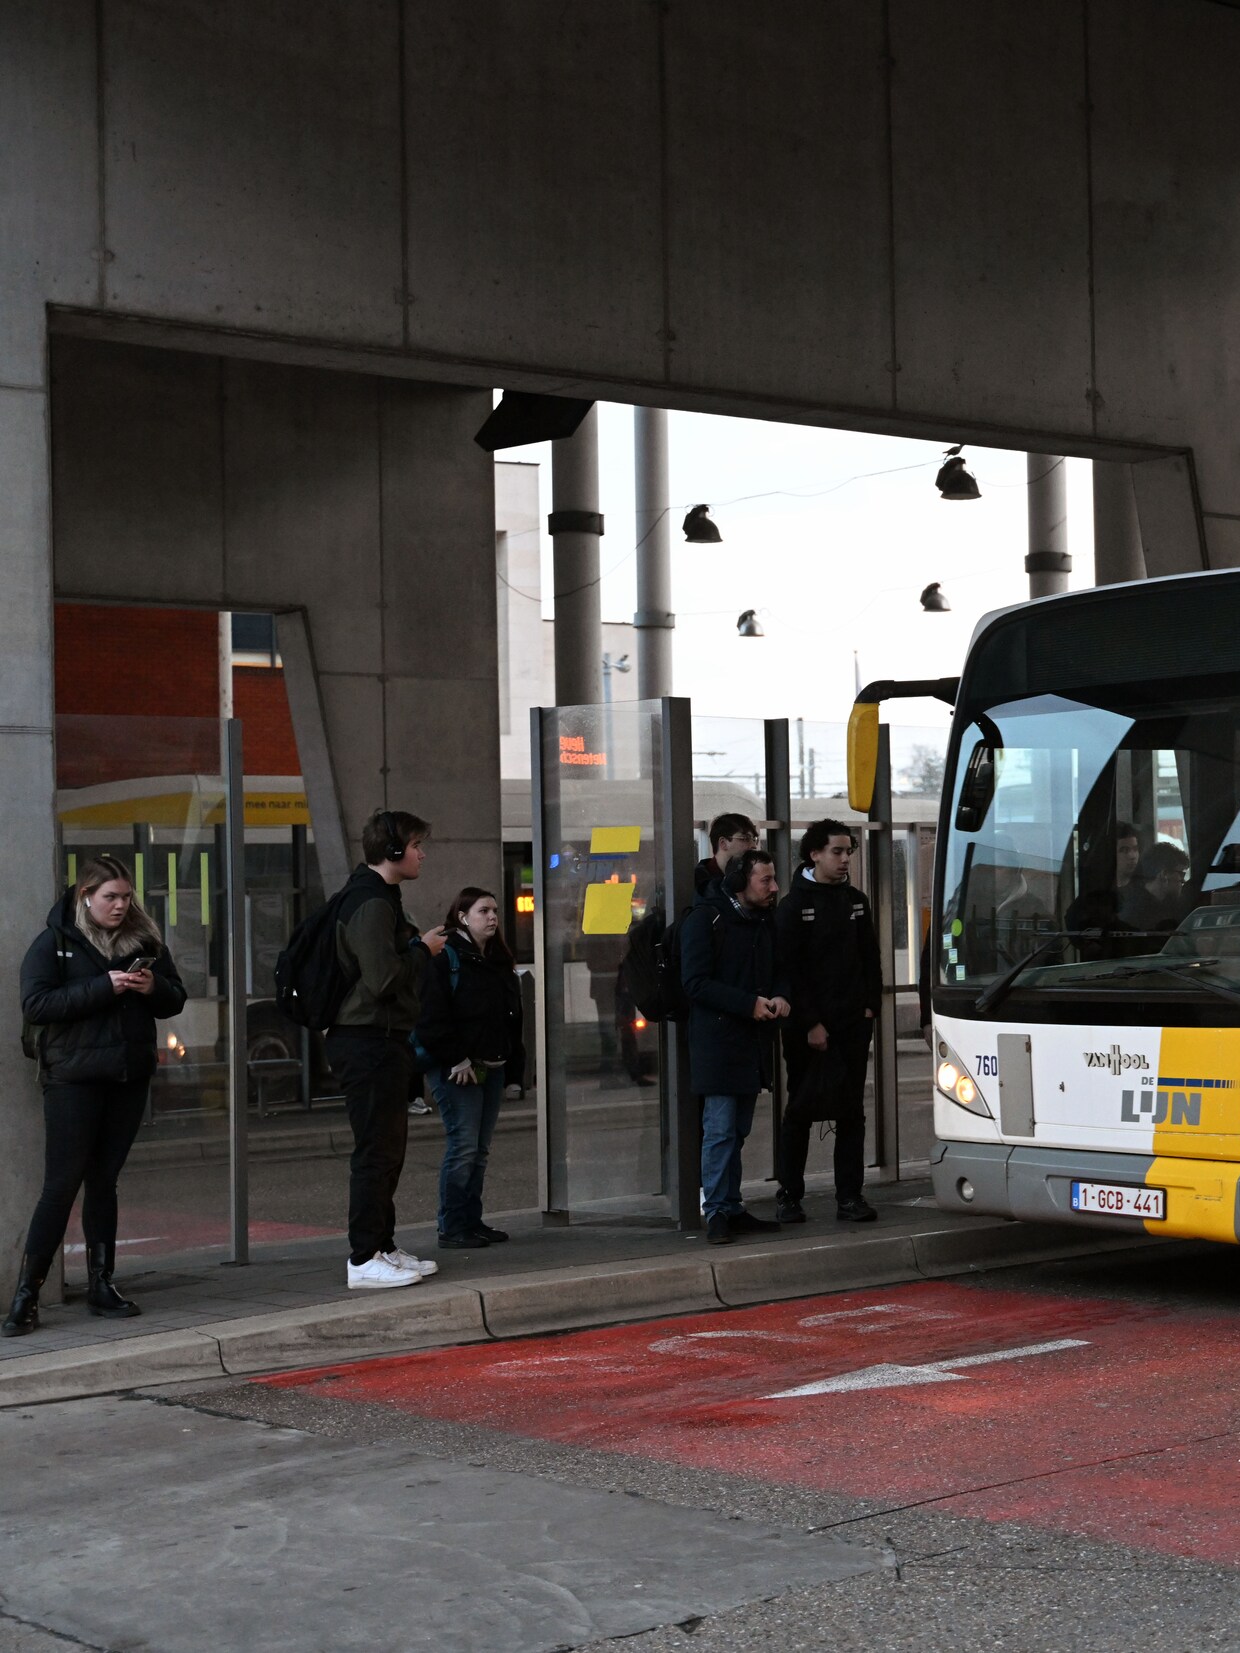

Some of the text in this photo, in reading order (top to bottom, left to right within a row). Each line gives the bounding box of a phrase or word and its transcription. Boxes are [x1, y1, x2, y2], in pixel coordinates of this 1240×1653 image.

[976, 1055, 998, 1076] 760
[1140, 1076, 1154, 1086] DE
[1120, 1089, 1202, 1126] LIJN
[1072, 1187, 1160, 1214] B 1-GCB-441
